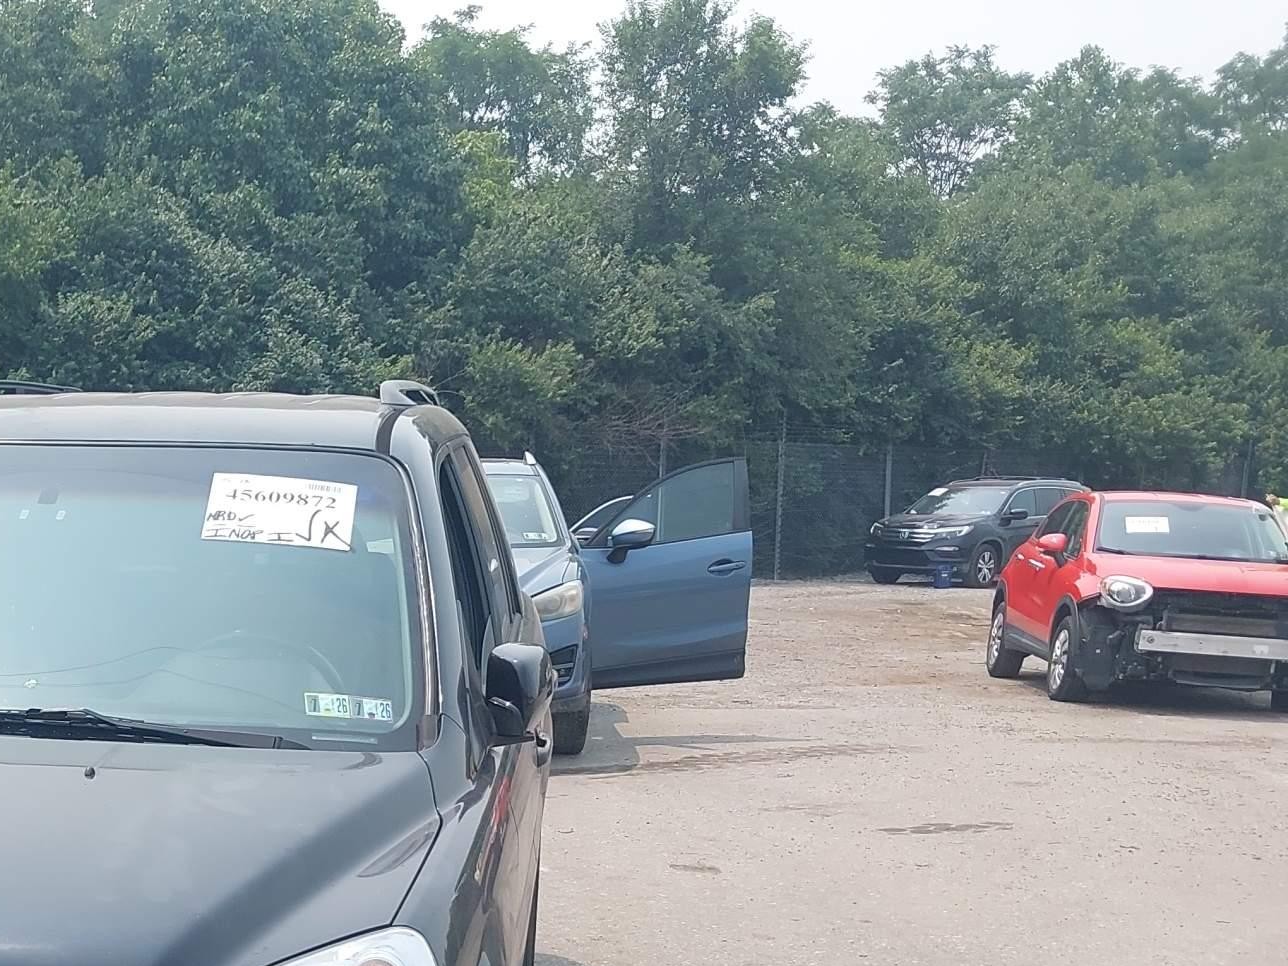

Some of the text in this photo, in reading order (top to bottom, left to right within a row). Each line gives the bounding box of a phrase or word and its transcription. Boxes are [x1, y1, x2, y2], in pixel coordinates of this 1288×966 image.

[226, 489, 337, 509] 45609872
[336, 698, 348, 713] 26
[380, 703, 392, 718] 26
